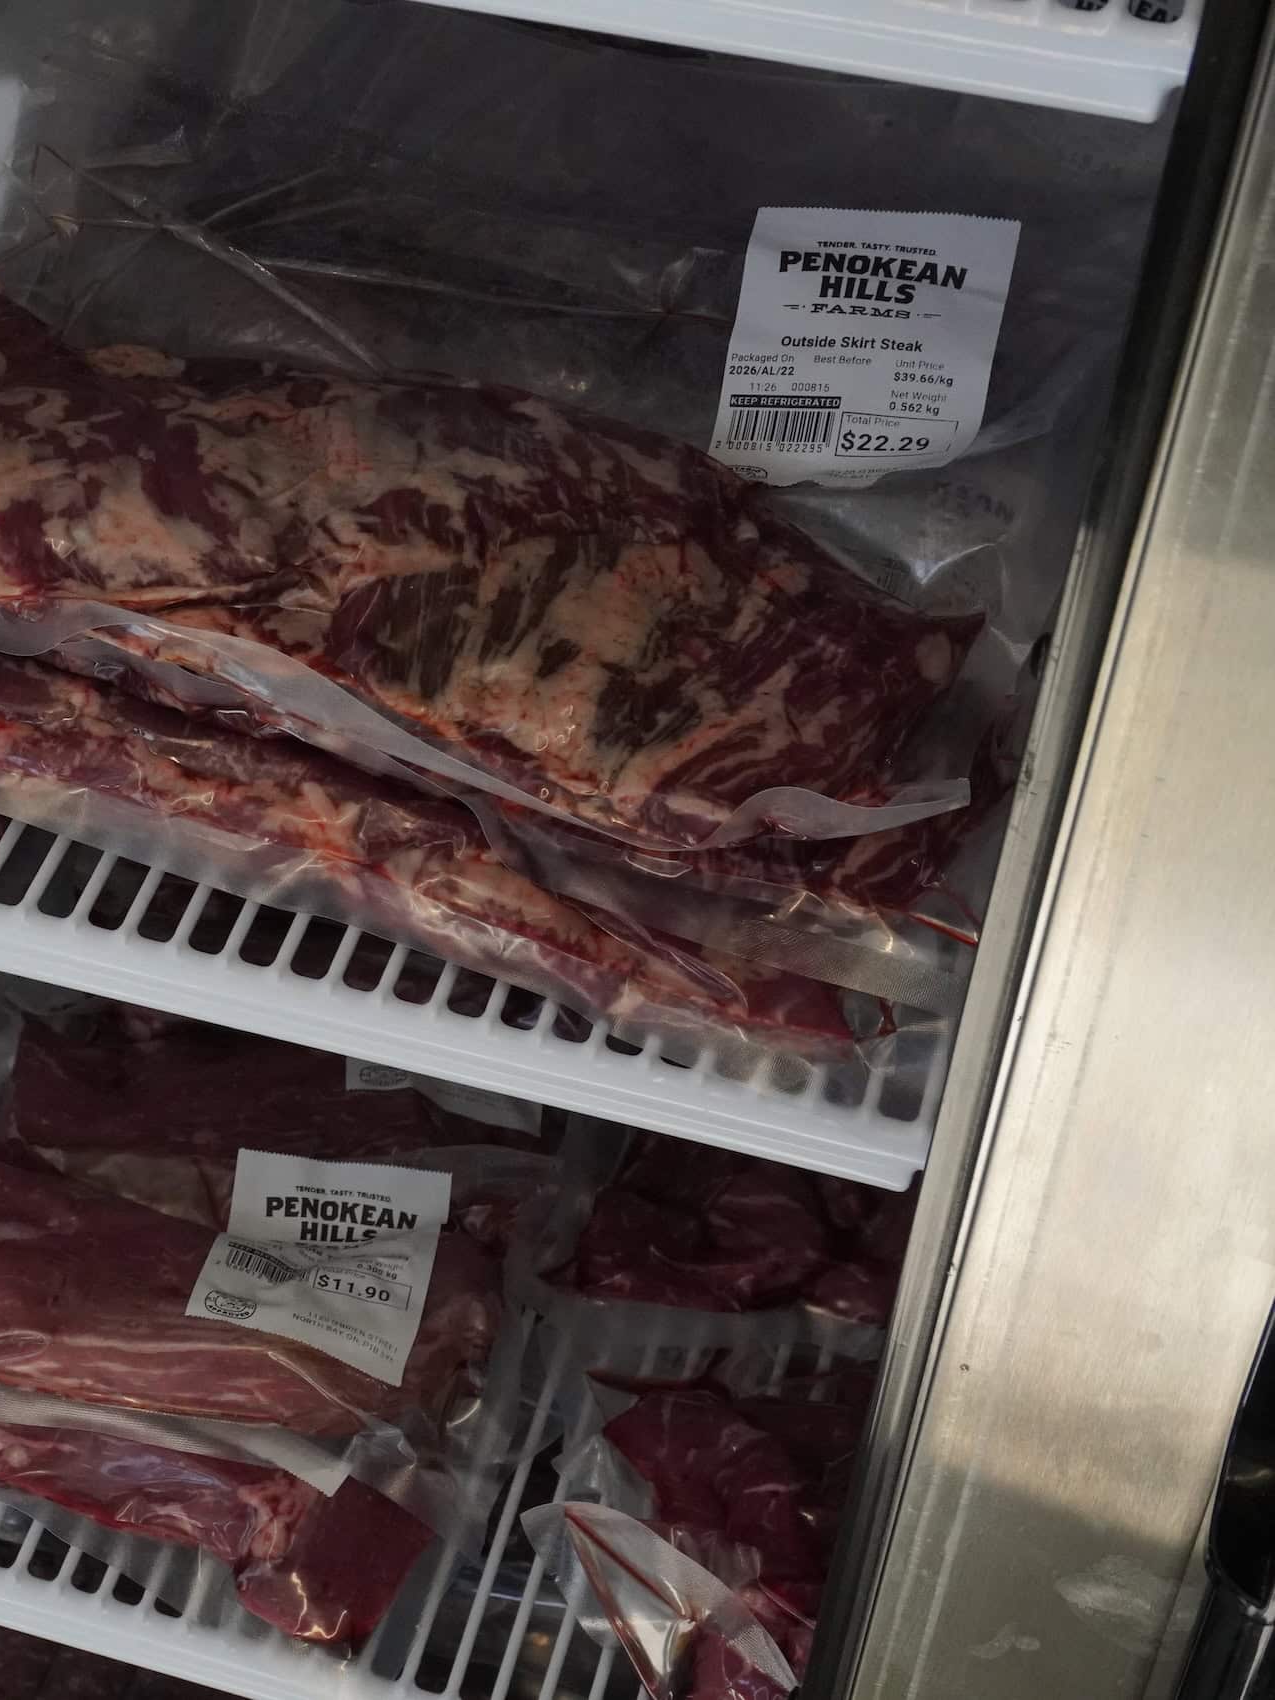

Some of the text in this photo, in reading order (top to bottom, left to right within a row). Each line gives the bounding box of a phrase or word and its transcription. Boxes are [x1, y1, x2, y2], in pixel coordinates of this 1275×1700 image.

[817, 241, 857, 249] TENDER.
[779, 250, 968, 289] PENOKEAN
[819, 275, 916, 304] HILLS
[810, 303, 911, 320] FARMS
[781, 335, 923, 353] Outside Skirt Steak
[731, 353, 795, 364] Packaged On
[813, 354, 872, 366] Best Before
[895, 359, 917, 370] Unit
[728, 366, 795, 377] 2026/AL/22
[893, 371, 954, 388] $39.66/kg
[791, 383, 830, 393] 000815
[890, 389, 913, 400] Net
[730, 396, 841, 408] KEEP REFRIGERATED
[925, 403, 940, 417] kg
[846, 414, 872, 426] Total
[840, 430, 931, 453] $22.29
[265, 1196, 419, 1230] PENOKEAN
[300, 1221, 378, 1243] HILLS
[317, 1273, 390, 1302] $11.90
[208, 1304, 250, 1318] APPROVED
[292, 1312, 325, 1328] NORTH
